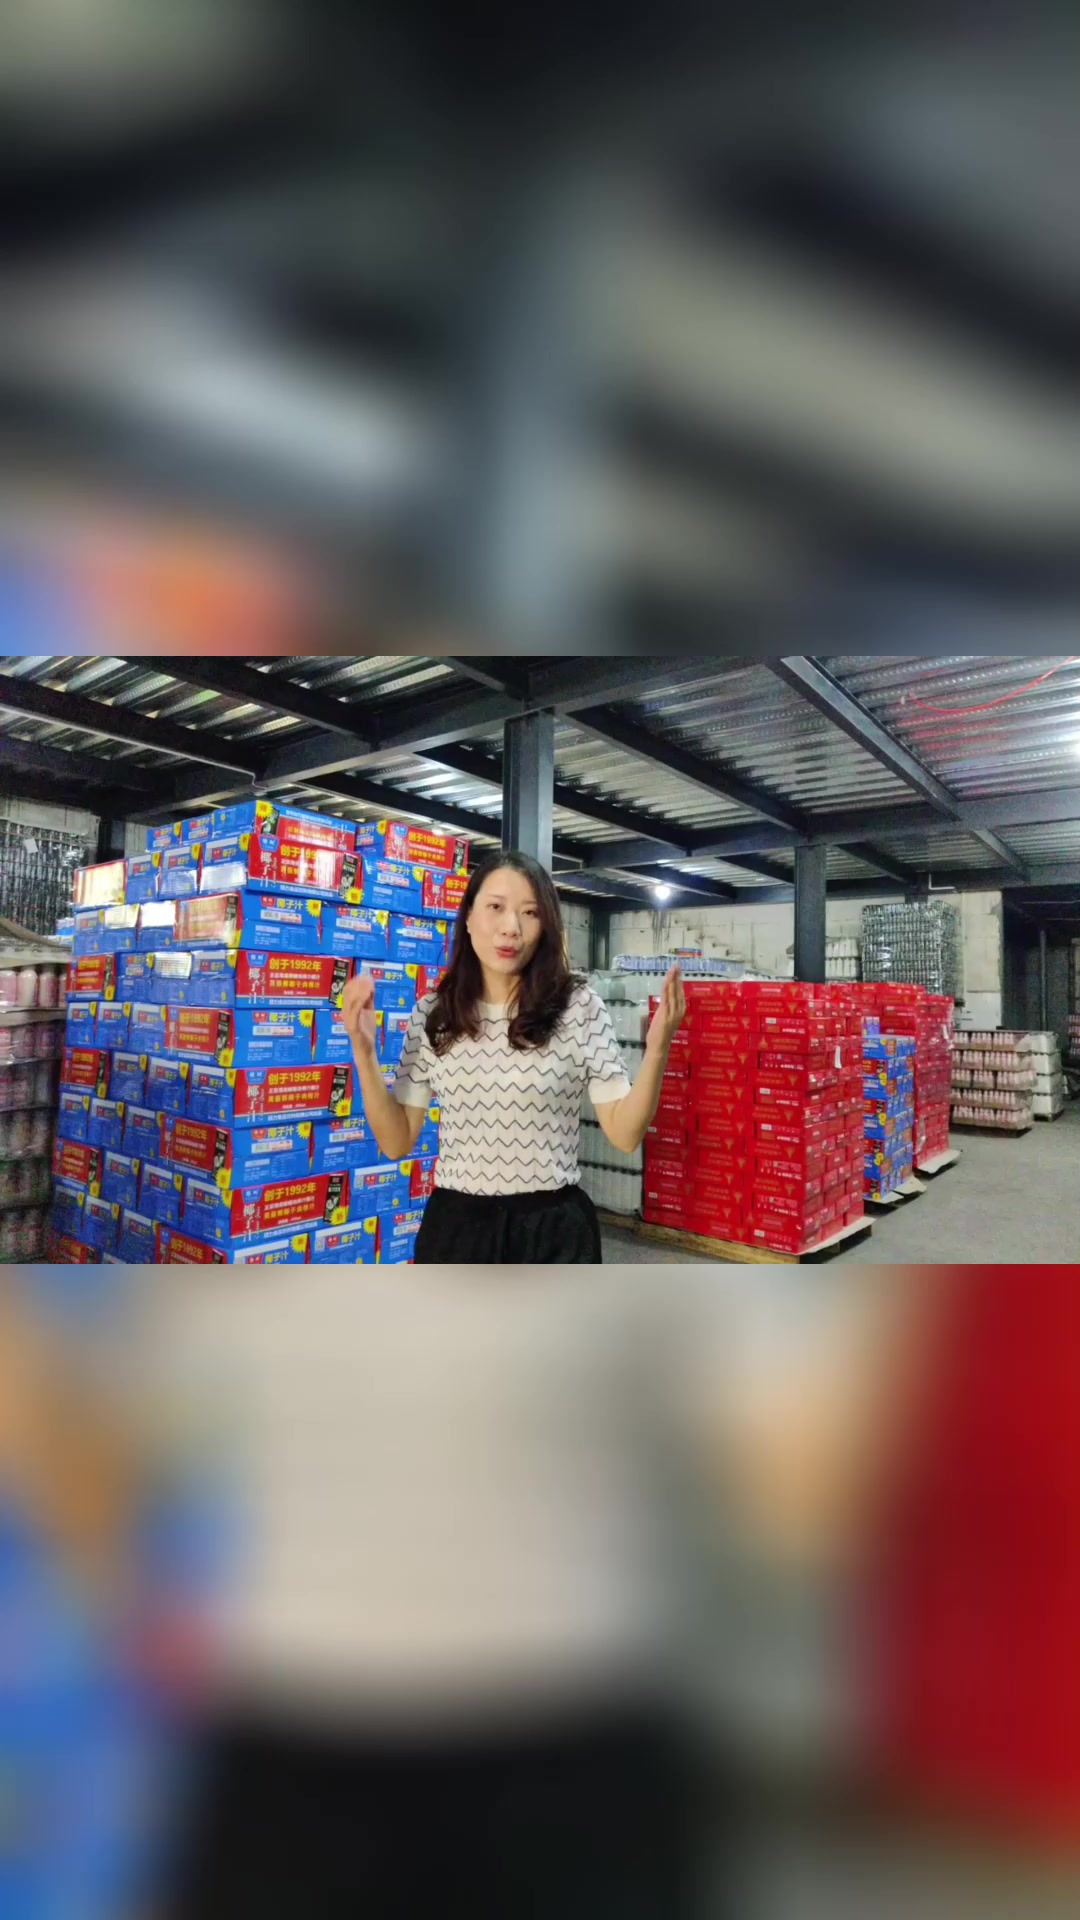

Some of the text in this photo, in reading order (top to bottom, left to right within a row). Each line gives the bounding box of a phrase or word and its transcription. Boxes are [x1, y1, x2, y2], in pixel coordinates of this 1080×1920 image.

[269, 958, 322, 971] 创于1992年
[269, 1011, 296, 1022] 椰子汁
[268, 1071, 321, 1085] 创于1992年
[268, 1125, 294, 1138] 椰子汁
[264, 1182, 317, 1202] 创于1992年
